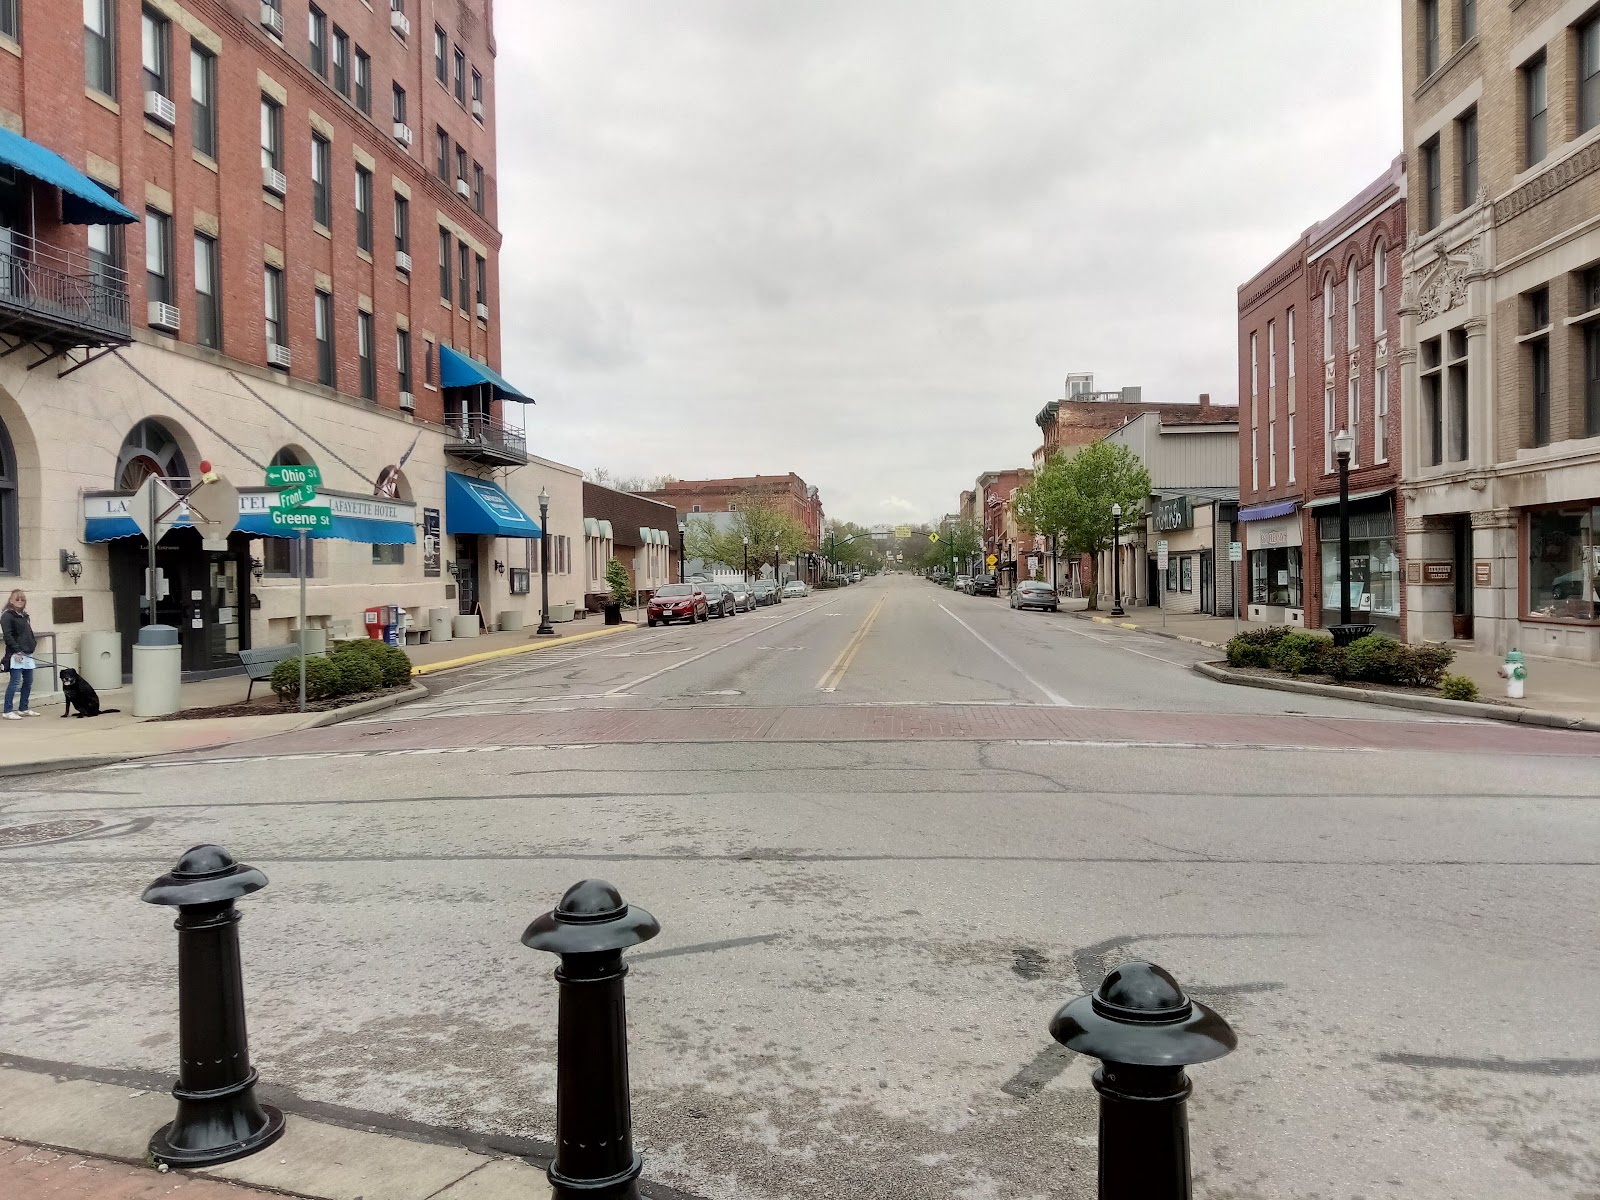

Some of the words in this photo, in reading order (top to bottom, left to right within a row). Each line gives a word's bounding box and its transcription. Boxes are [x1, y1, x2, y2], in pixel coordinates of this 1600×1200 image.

[281, 469, 306, 482] Ohio
[308, 469, 317, 478] St
[281, 489, 302, 508] Front
[306, 485, 313, 494] St
[330, 499, 372, 515] LAFAYETTE
[374, 505, 398, 518] HOTEL
[272, 512, 317, 525] Greene
[320, 516, 330, 525] St
